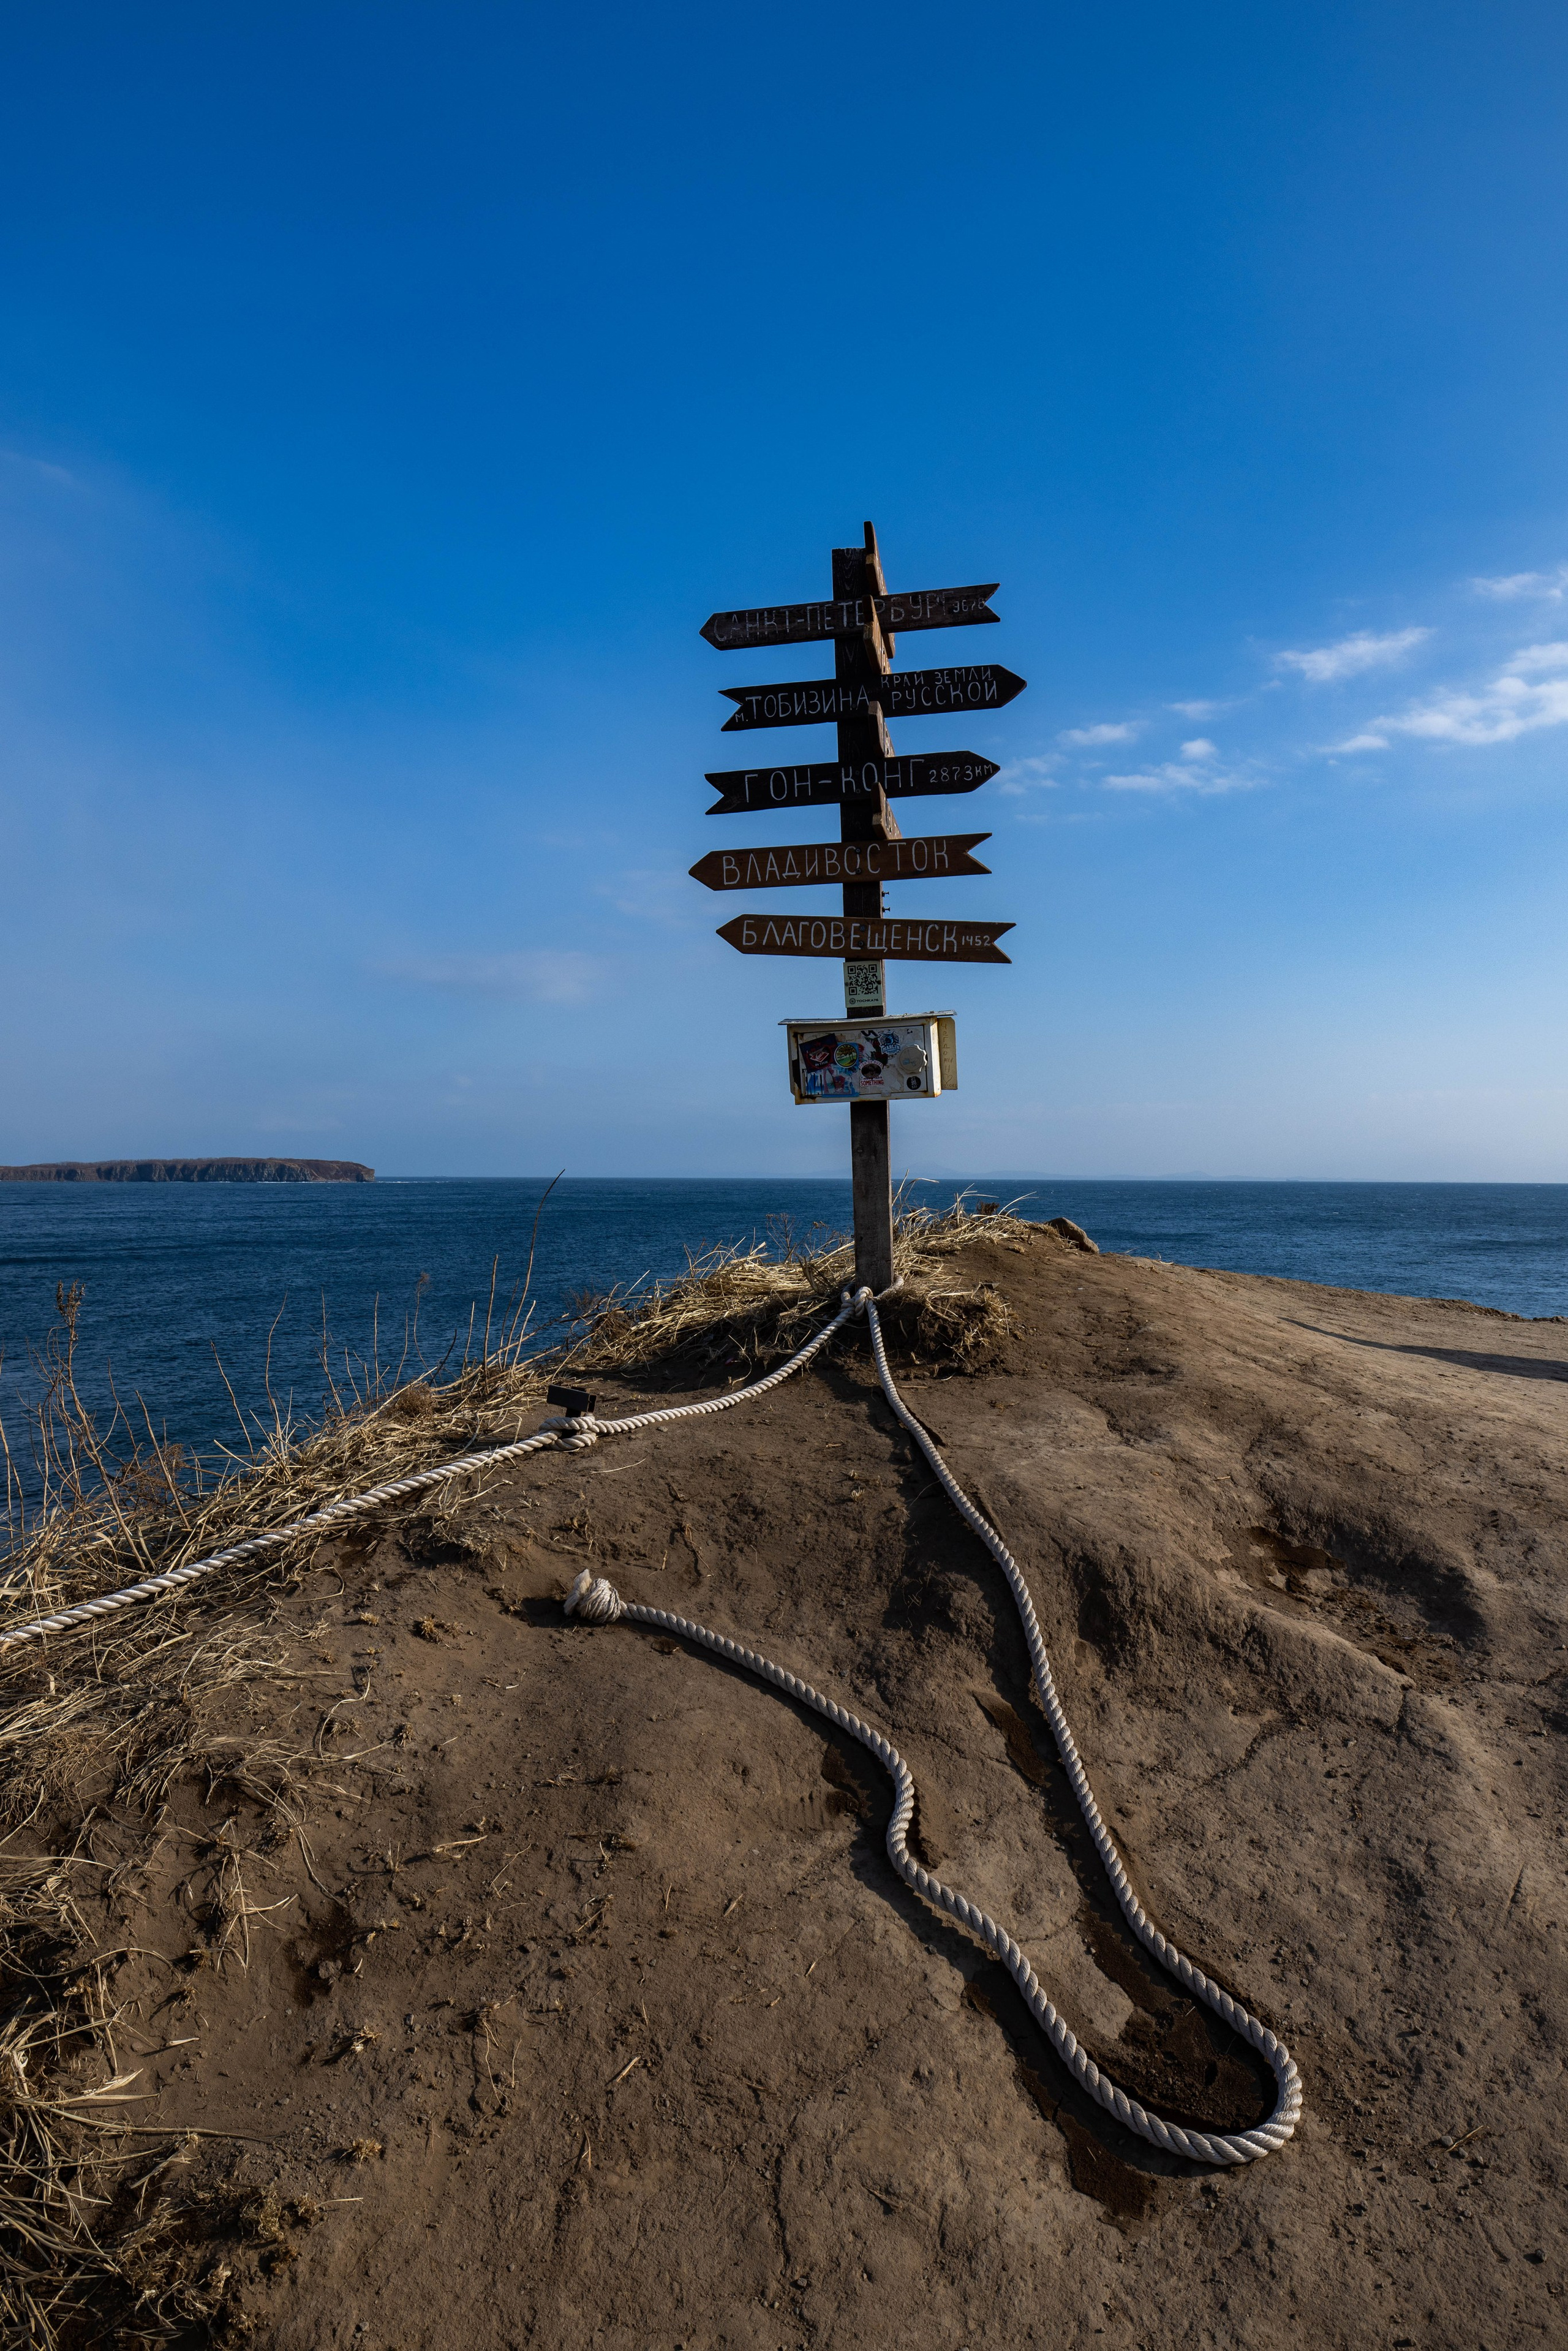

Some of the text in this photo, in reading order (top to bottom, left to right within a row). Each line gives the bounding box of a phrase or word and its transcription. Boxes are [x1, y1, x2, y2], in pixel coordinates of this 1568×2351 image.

[934, 666, 991, 685] ЗЕМЛИ
[745, 685, 869, 720] ТОБИЗИНА
[891, 677, 997, 709] РУССКОЙ
[744, 759, 925, 803] ГОН-КОНГ
[723, 839, 949, 885] ВЛАДИВОСТОК
[742, 920, 991, 953] БЛАГОВЕЩЕНСК 1452
